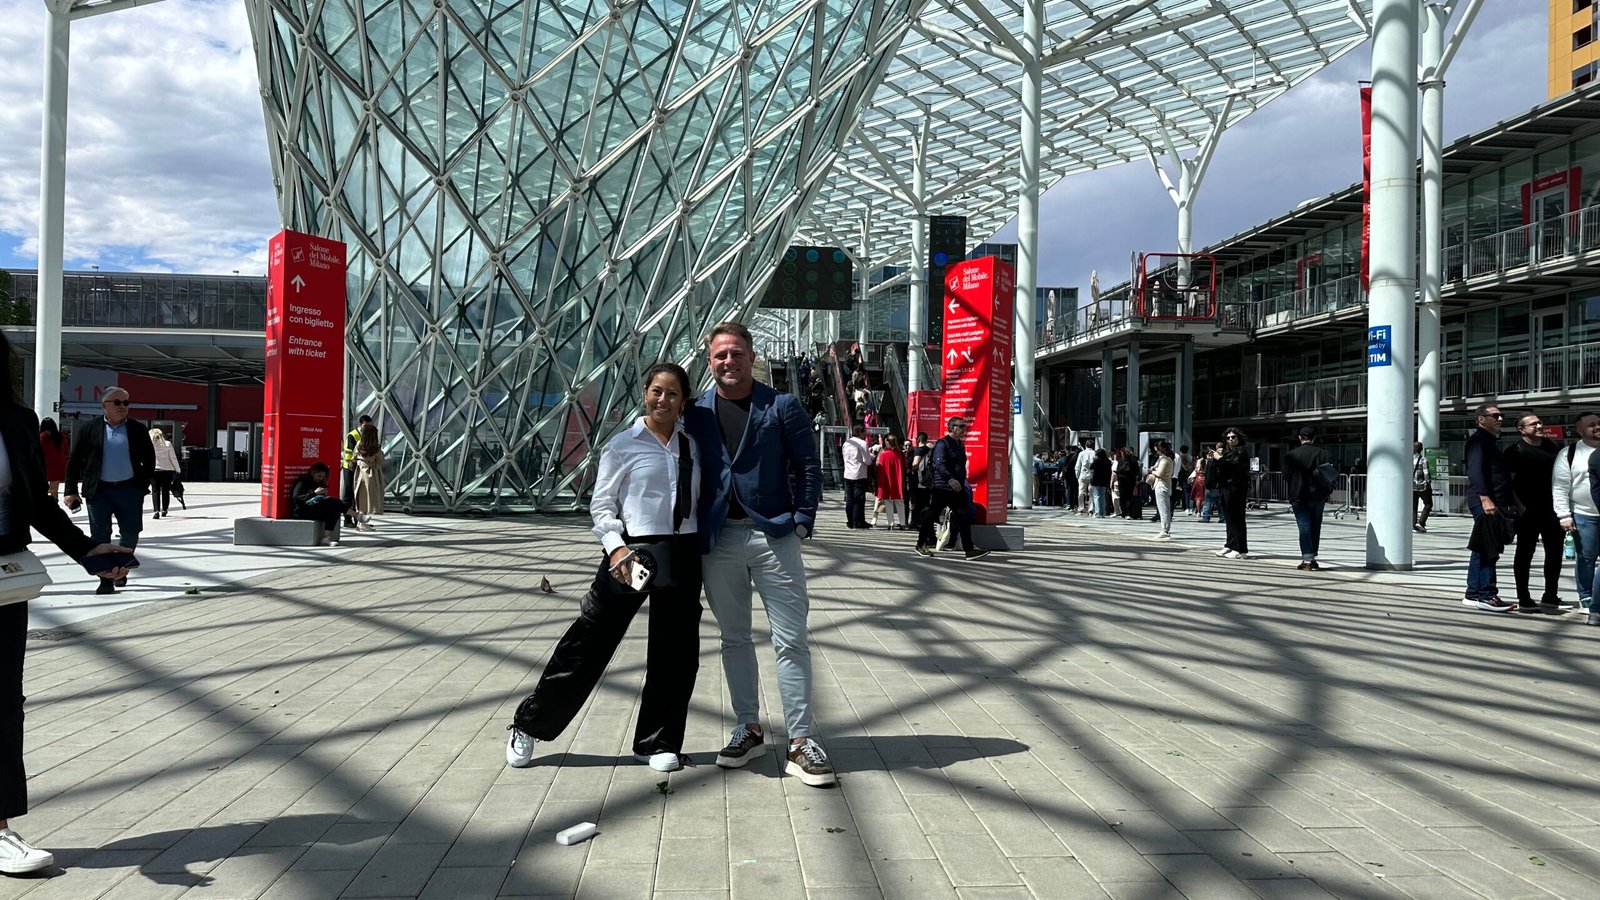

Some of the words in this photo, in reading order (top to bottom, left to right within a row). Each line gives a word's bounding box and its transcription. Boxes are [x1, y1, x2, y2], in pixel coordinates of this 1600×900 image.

[310, 242, 328, 252] Salone
[310, 252, 318, 260] del
[310, 260, 330, 269] Milano
[290, 304, 322, 316] Ingresso
[290, 316, 304, 324] con
[305, 317, 334, 328] biglietto
[289, 336, 322, 347] Entrance
[289, 348, 304, 356] with
[306, 350, 326, 358] ticket
[1370, 354, 1386, 362] TIM
